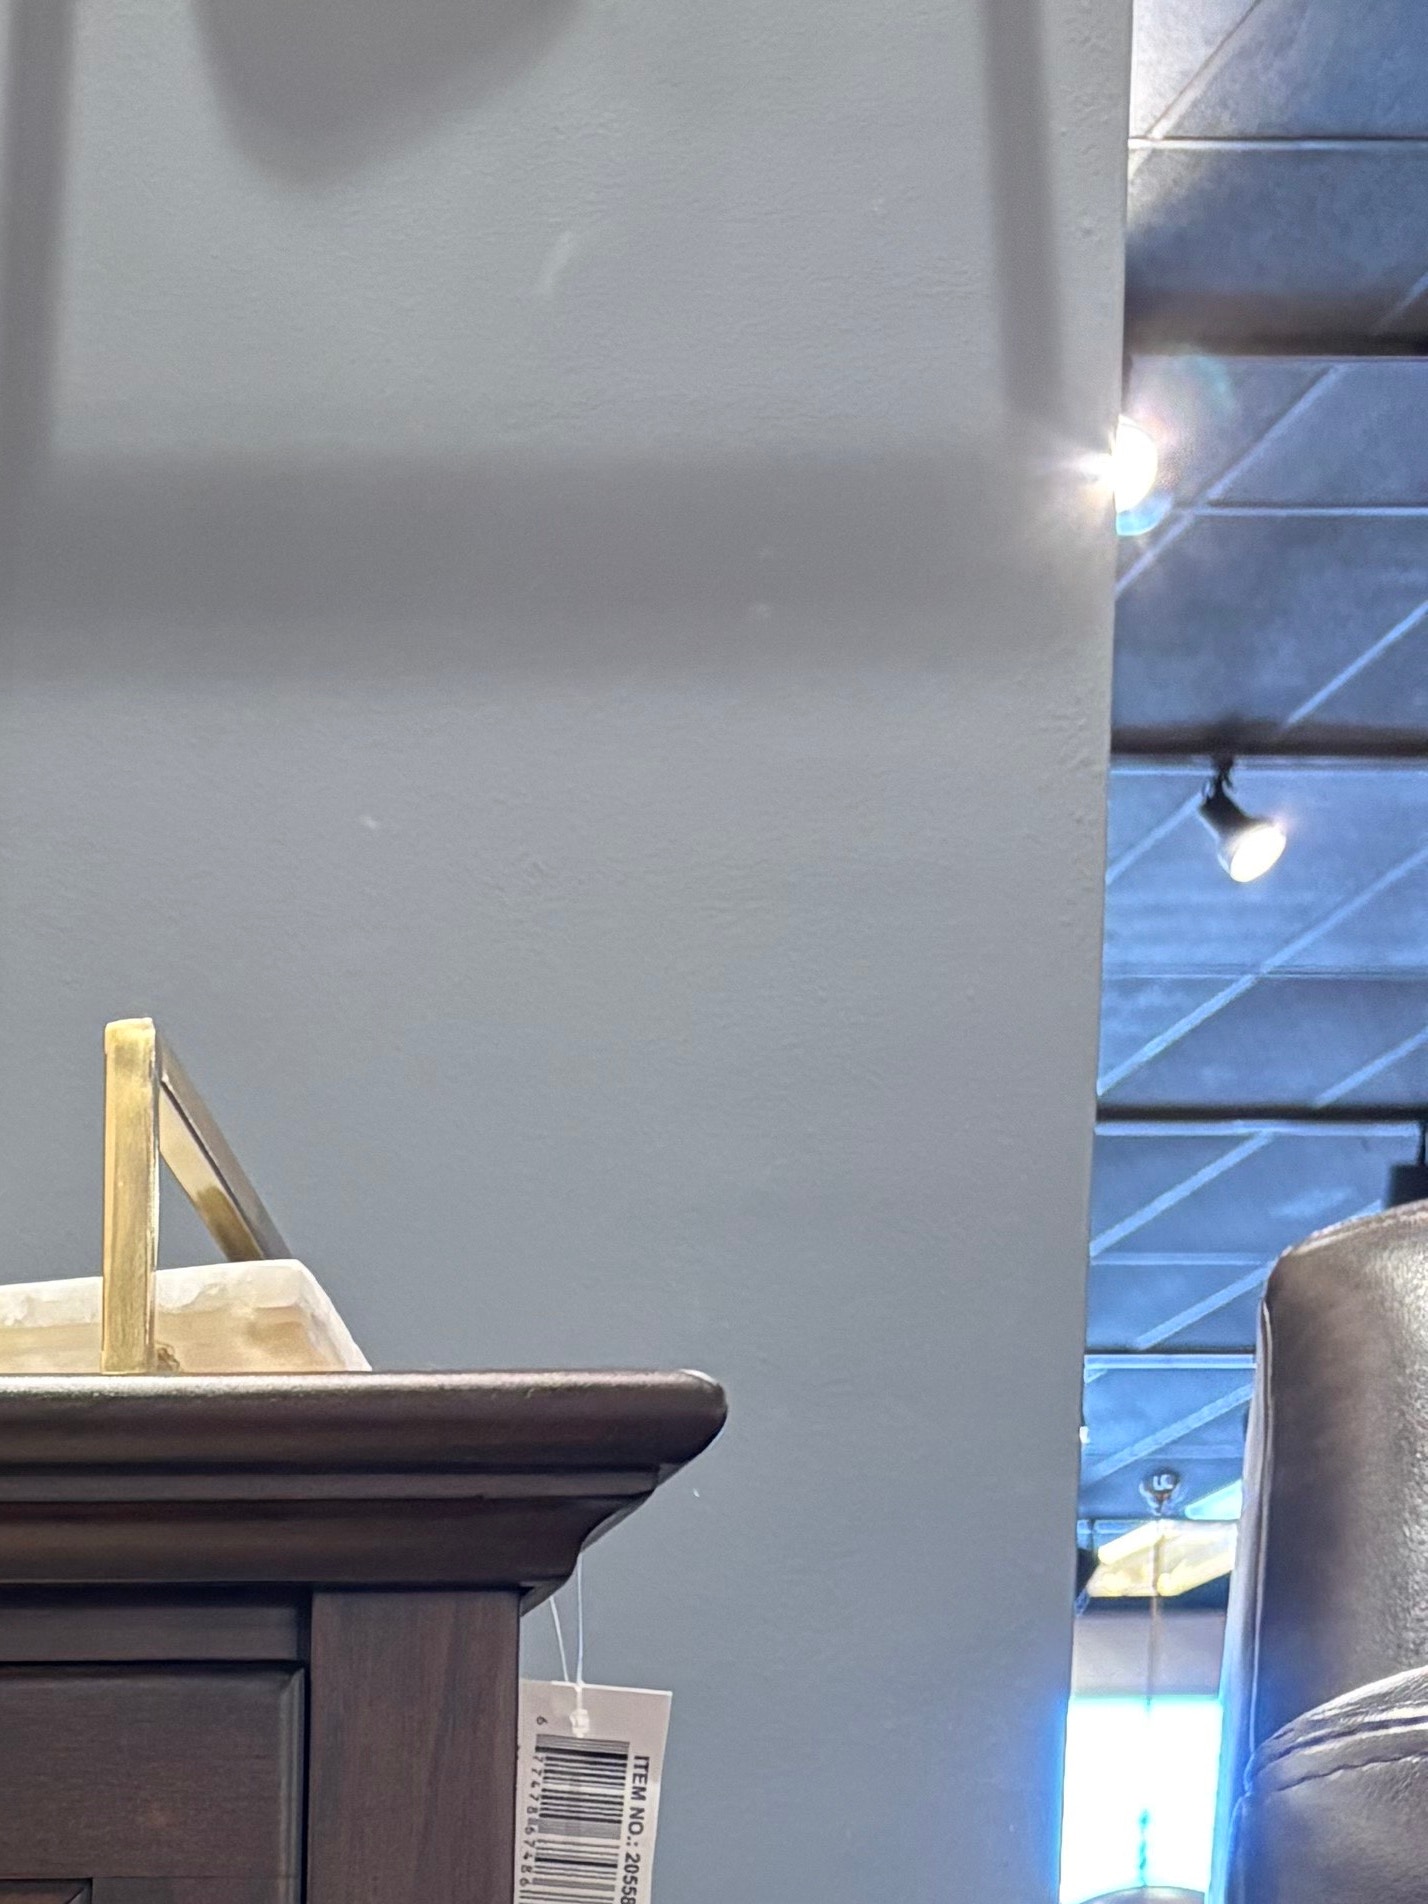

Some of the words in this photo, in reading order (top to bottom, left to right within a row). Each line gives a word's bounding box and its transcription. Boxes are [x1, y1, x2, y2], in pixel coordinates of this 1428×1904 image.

[536, 1714, 549, 1726] 6
[526, 1755, 545, 1816] 77478
[632, 1755, 651, 1802] ITEM
[626, 1806, 645, 1848] NO.:
[519, 1825, 537, 1888] 67486
